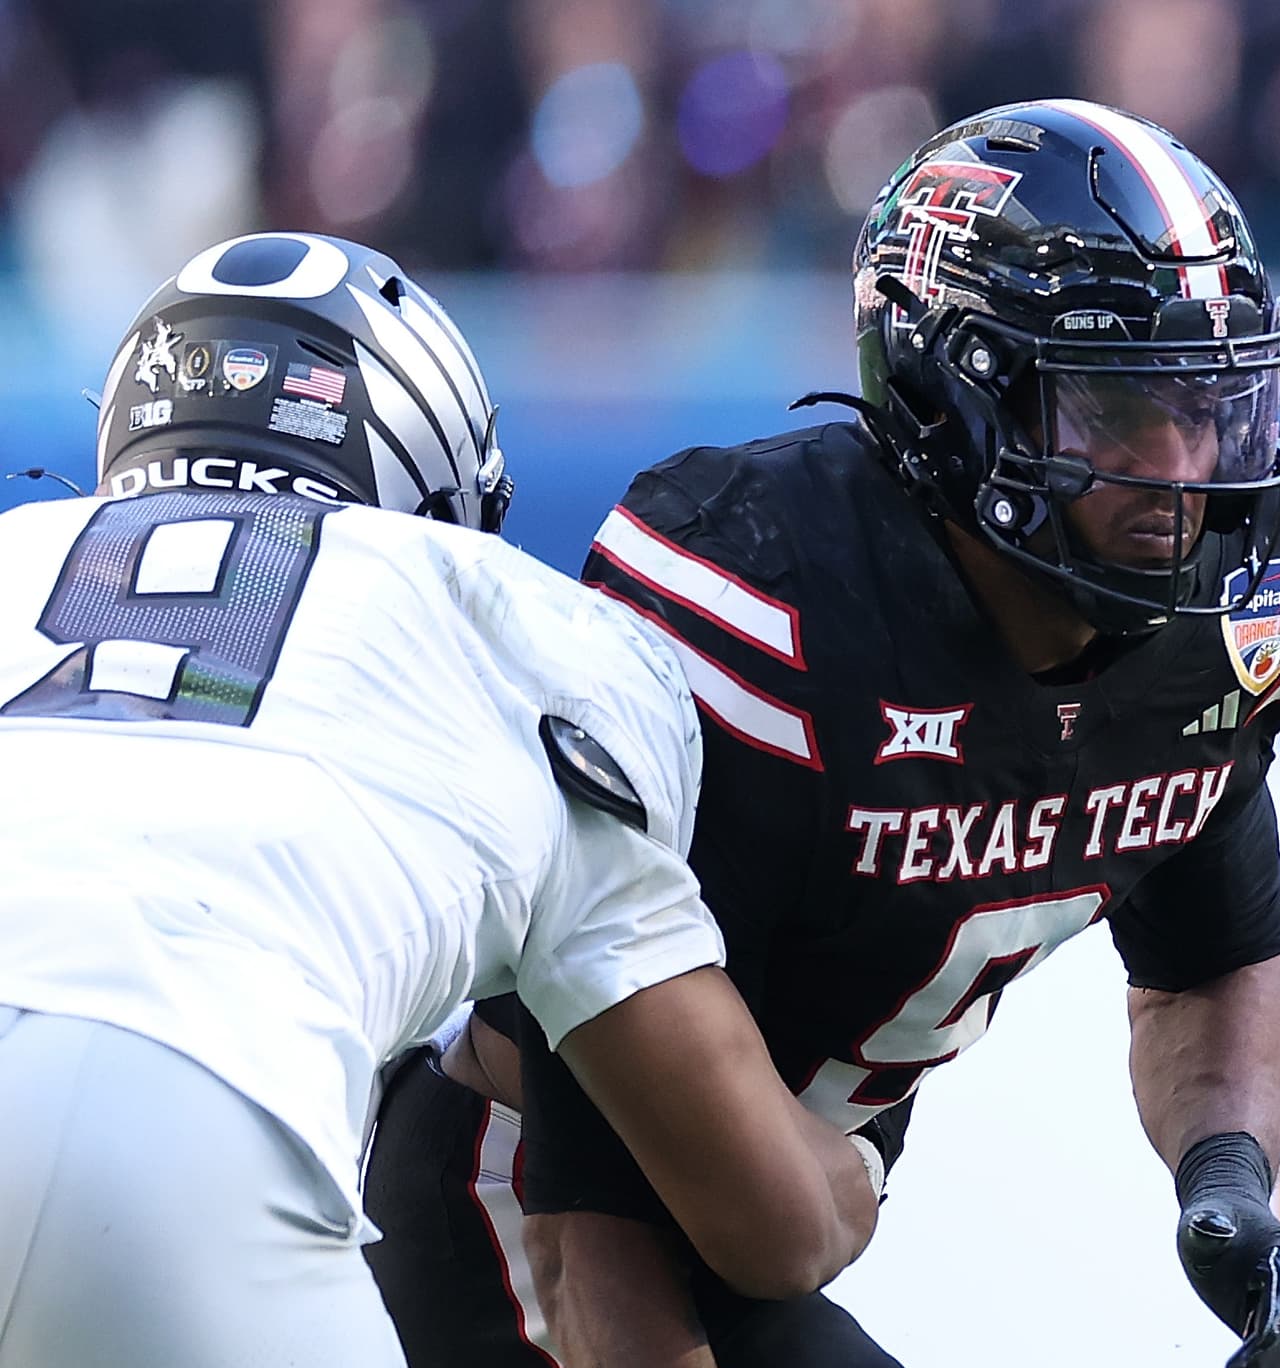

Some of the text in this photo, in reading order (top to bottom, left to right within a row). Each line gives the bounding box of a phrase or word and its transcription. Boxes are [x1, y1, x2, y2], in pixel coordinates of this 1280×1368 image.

[1063, 315, 1114, 330] GUNS UP
[1235, 620, 1277, 649] ORANGE
[848, 761, 1234, 885] TEXAS TECH
